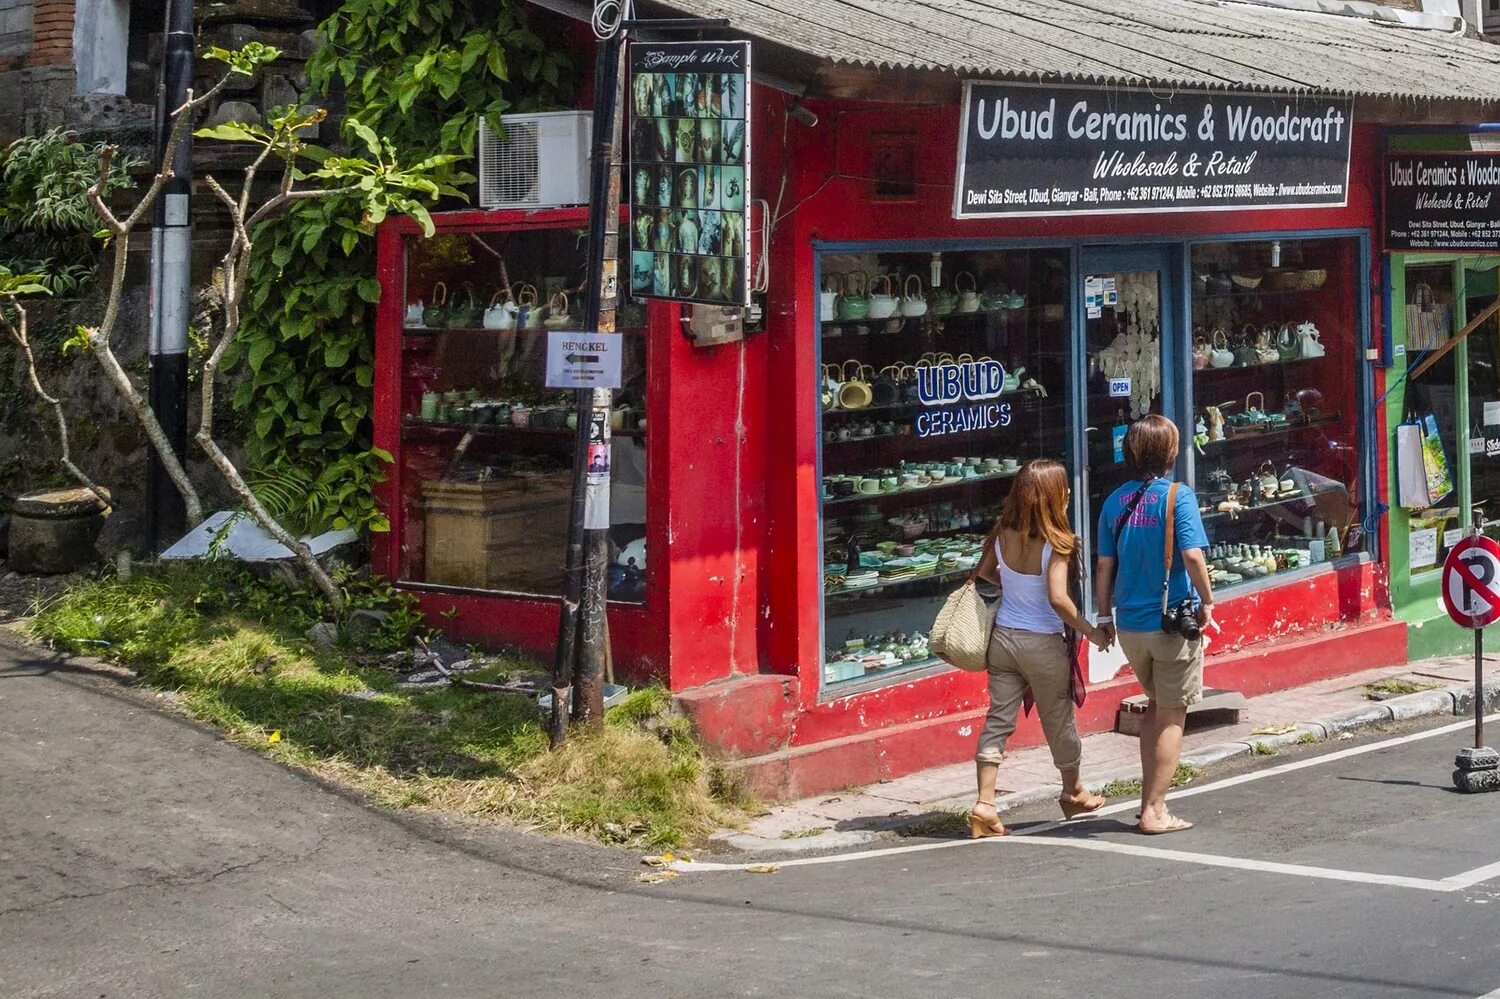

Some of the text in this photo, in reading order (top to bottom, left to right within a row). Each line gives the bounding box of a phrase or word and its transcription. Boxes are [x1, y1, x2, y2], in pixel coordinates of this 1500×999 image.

[643, 49, 698, 69] Sample
[977, 97, 1345, 143] Ubud Ceramics & Woodcraft
[1093, 150, 1258, 181] Wholesale & Retail
[1390, 161, 1413, 187] Ubud
[1416, 161, 1457, 187] Ceramics
[1460, 168, 1466, 185] &
[967, 189, 987, 205] Dewi
[988, 188, 1003, 204] Sita
[1004, 187, 1028, 206] Street,
[1029, 187, 1051, 205] Ubud,
[1052, 186, 1079, 206] Gianyar
[1084, 186, 1100, 204] Bali,
[1100, 185, 1122, 201] Phone
[1127, 187, 1138, 201] +62
[1139, 187, 1151, 201] 361
[1176, 185, 1197, 200] Mobile
[1254, 184, 1275, 197] Website
[1415, 191, 1492, 210] Wholesale & Retail
[1410, 239, 1430, 247] Website
[562, 341, 608, 352] BENGKEL
[915, 360, 1005, 406] UBUD
[1112, 381, 1130, 394] OPEN
[915, 401, 1011, 438] CERAMICS
